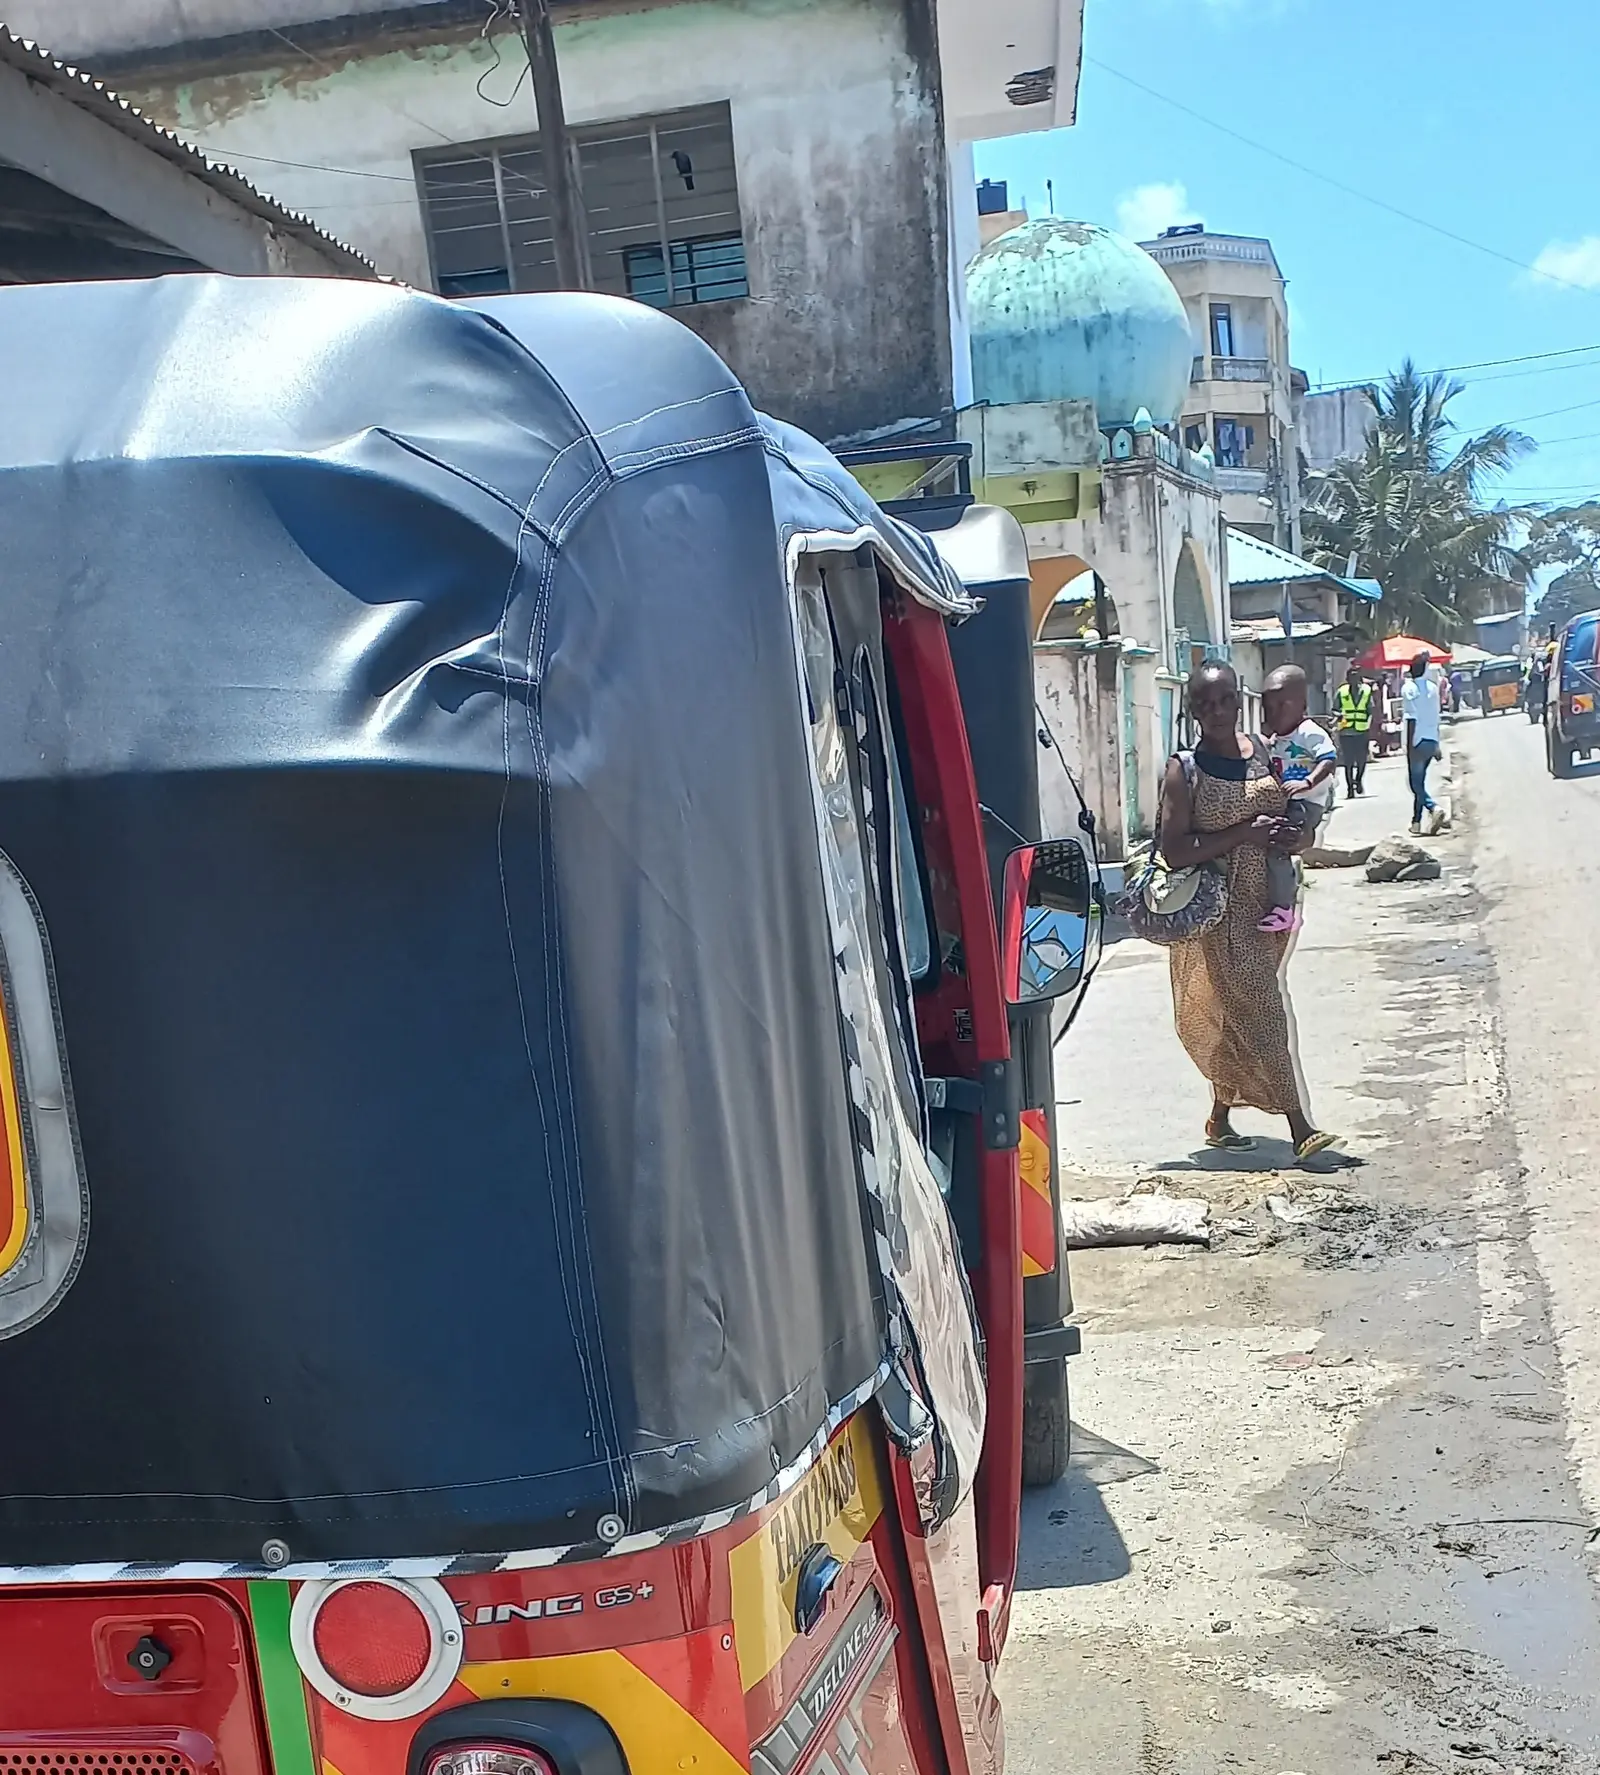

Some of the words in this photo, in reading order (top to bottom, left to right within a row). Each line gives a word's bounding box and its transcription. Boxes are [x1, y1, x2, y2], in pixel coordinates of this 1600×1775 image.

[770, 1484, 814, 1584] TAXI
[818, 1437, 856, 1527] PASS
[595, 1580, 655, 1608] GS+
[813, 1623, 863, 1720] DELUXE
[861, 1608, 877, 1645] PLUS
